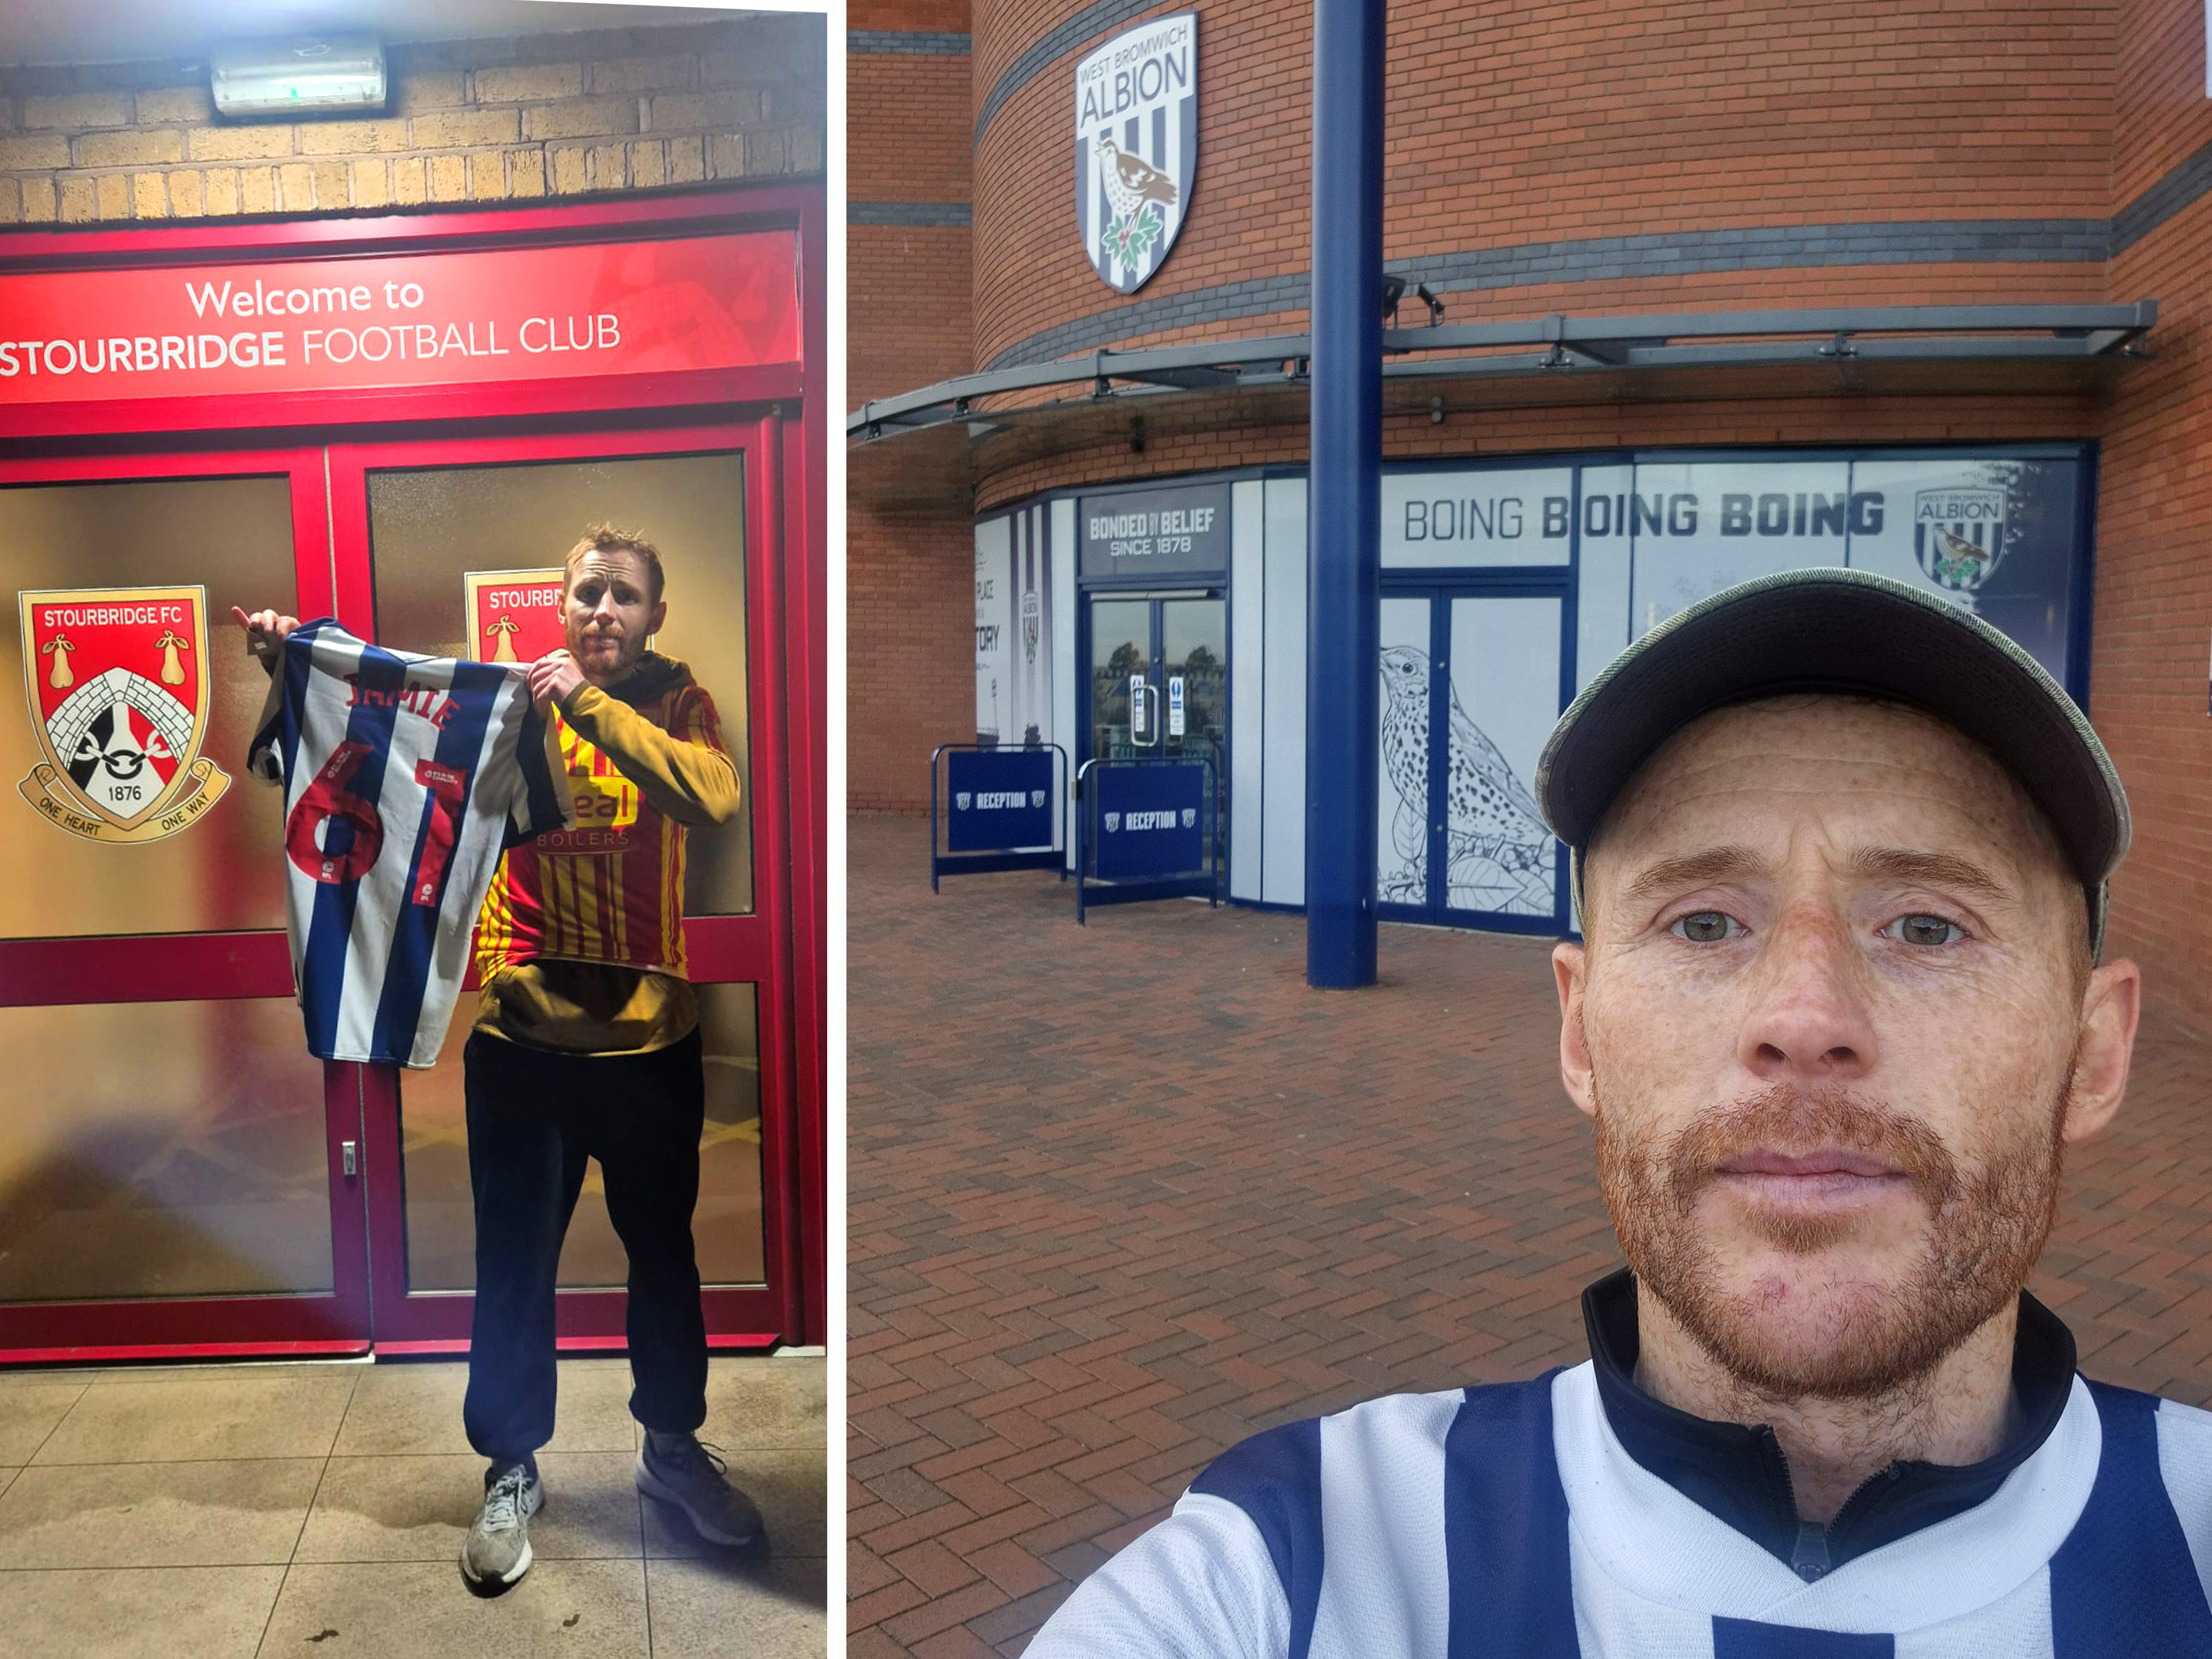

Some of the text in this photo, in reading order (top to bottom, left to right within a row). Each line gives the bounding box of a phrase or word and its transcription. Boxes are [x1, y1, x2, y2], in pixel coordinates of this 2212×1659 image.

[1079, 23, 1188, 85] WEST BROMWICH
[1079, 45, 1187, 129] ALBION
[185, 278, 425, 319] Welcome to
[0, 313, 621, 377] STOURBRIDGE FOOTBALL CLUB
[1090, 514, 1147, 540] BONDED
[1161, 508, 1215, 535] BELIEF
[1403, 492, 1886, 541] BOING BOING BOING
[1919, 503, 1999, 518] ALBION
[1111, 535, 1191, 556] SINCE 1878
[45, 606, 183, 628] STOURBRIDGE FC
[343, 673, 461, 731] JAMIE
[108, 786, 142, 801] 1876
[976, 792, 1026, 810] RECEPTION
[39, 796, 101, 836] ONE HEART
[161, 792, 210, 831] ONE WAY
[1125, 810, 1177, 830] RECEPTION
[537, 832, 630, 846] BOILERS
